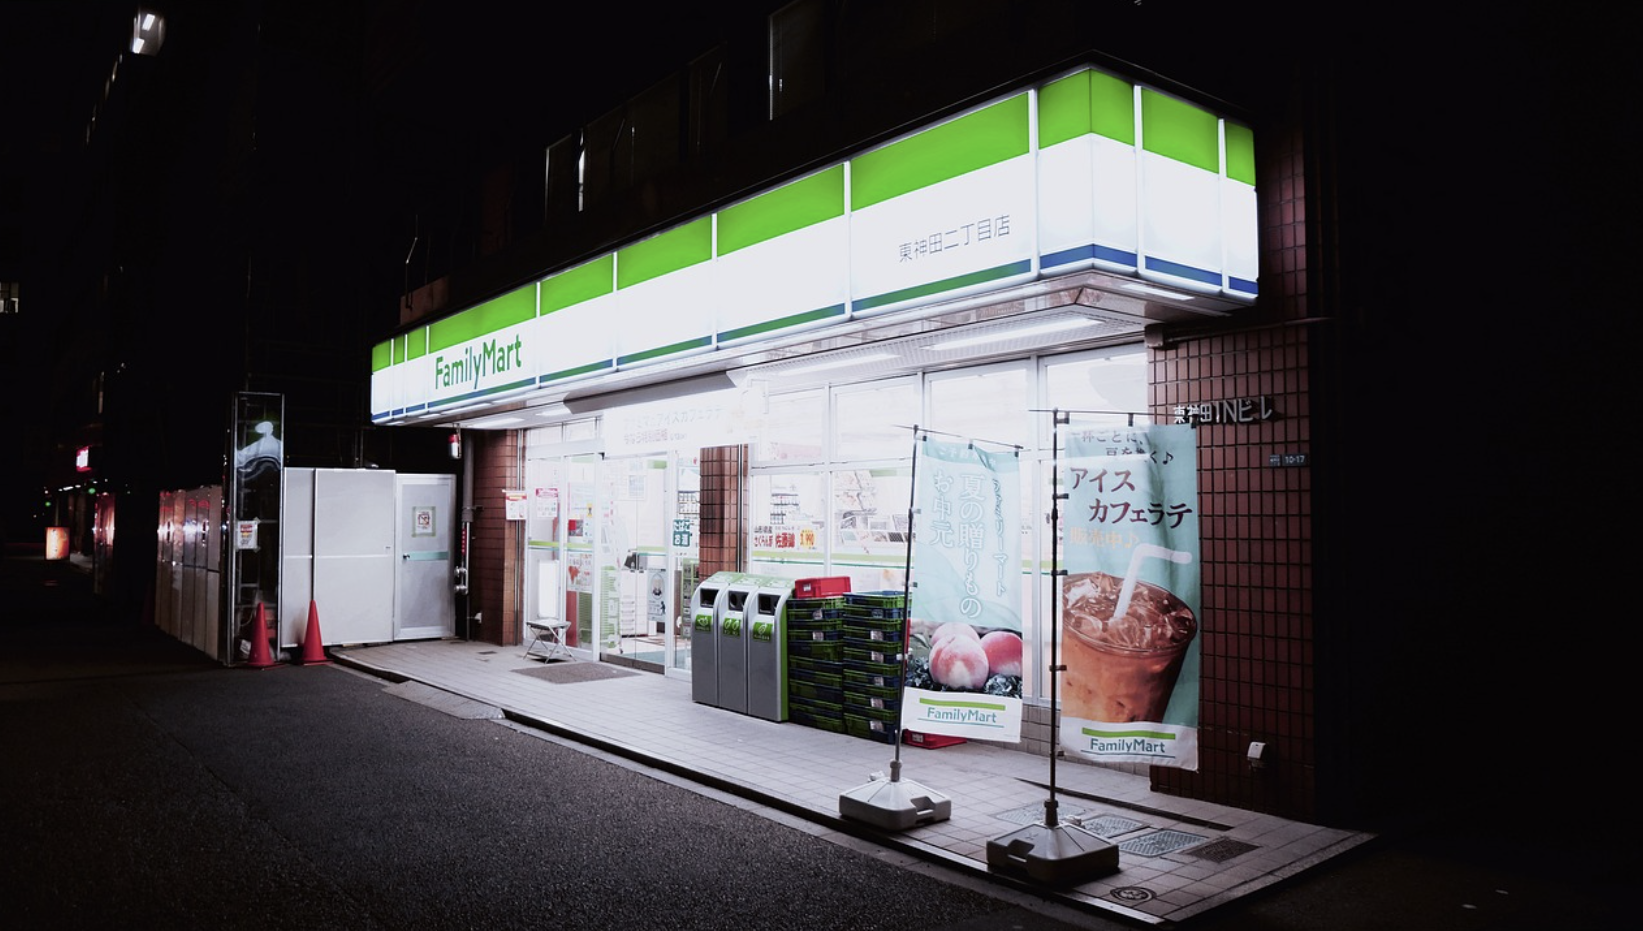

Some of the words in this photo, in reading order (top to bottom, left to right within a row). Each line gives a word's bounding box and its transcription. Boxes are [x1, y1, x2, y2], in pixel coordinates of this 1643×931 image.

[898, 214, 1011, 263] 東神田二丁目店
[435, 334, 522, 390] FamilyMart
[1069, 466, 1136, 494] アイス
[930, 470, 955, 549] お中元
[1088, 498, 1193, 530] カフェラテ
[958, 472, 987, 620] 夏の贈りもの
[1069, 526, 1124, 550] 販売中
[927, 706, 997, 724] FamilyMart
[1090, 738, 1165, 753] FamilyMart
